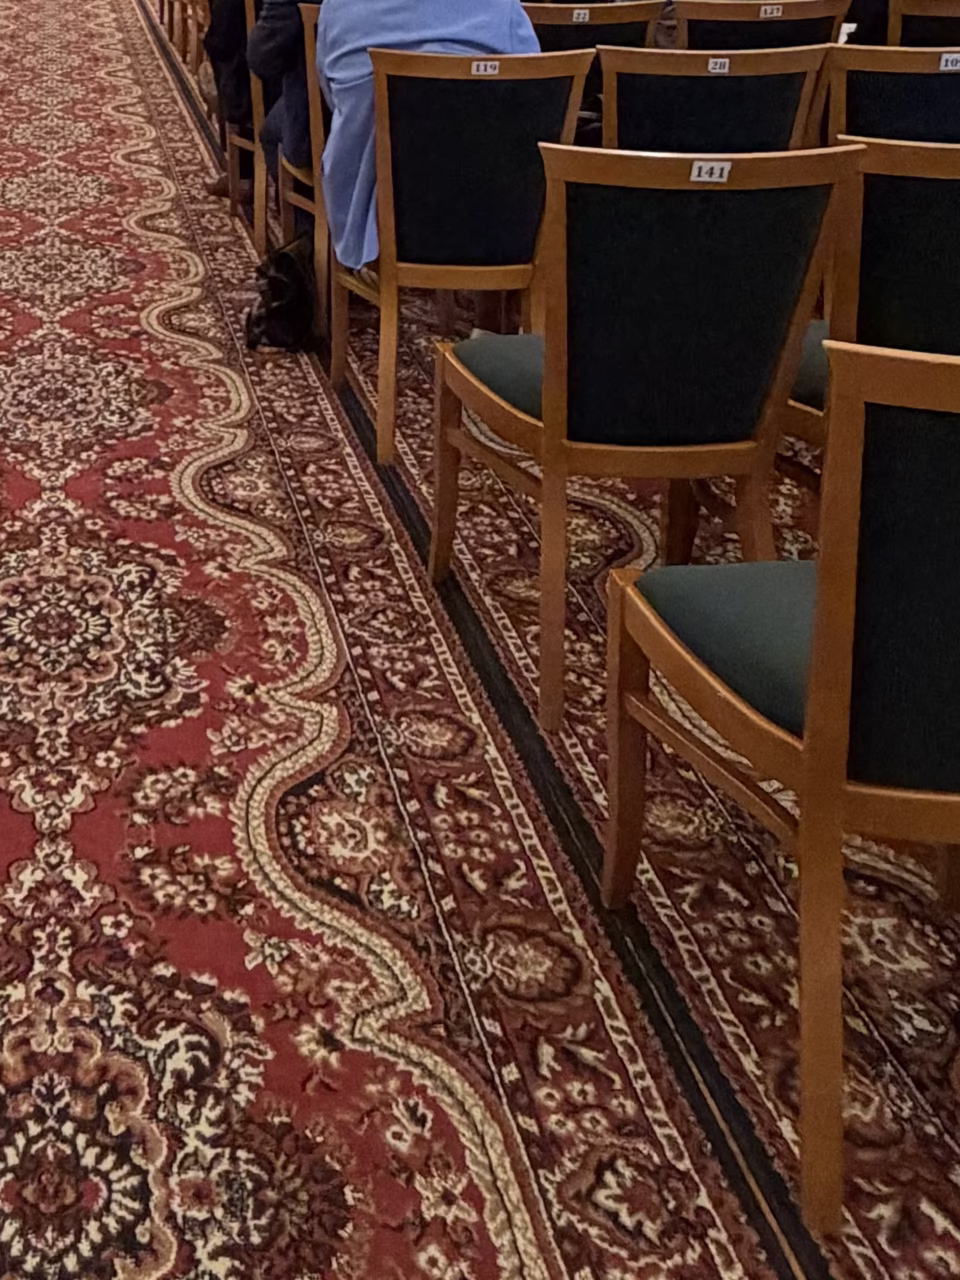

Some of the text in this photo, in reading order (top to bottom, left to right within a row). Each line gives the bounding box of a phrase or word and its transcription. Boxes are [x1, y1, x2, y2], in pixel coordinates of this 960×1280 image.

[475, 63, 497, 73] 119
[711, 61, 727, 71] 28
[696, 165, 725, 179] 141
